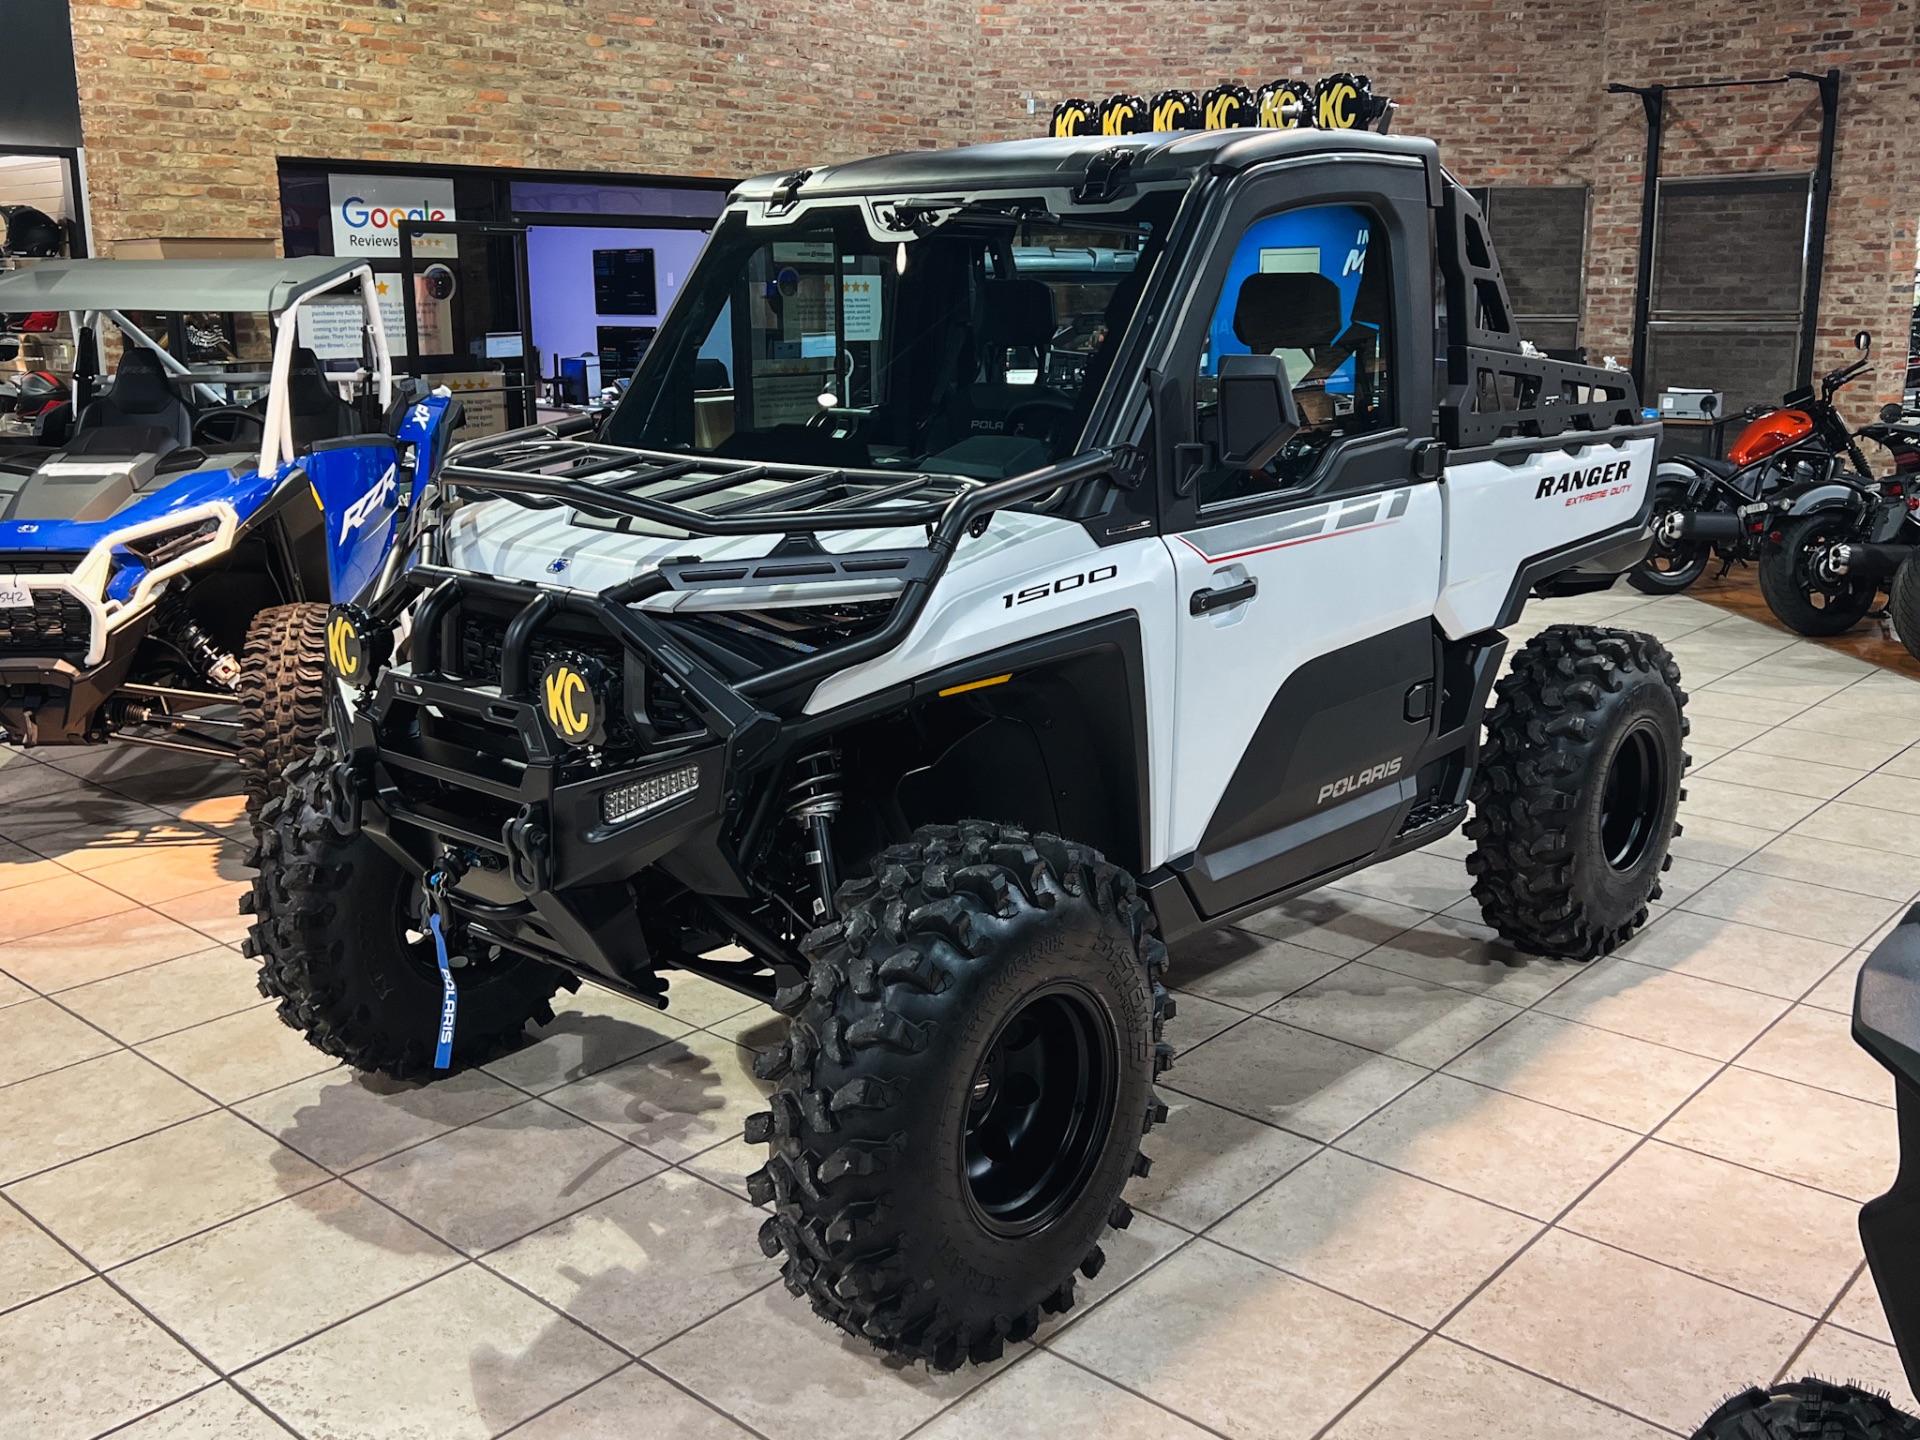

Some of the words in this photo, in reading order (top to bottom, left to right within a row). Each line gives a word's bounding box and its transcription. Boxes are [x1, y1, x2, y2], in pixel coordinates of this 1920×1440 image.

[1056, 107, 1085, 138] KC
[1103, 103, 1134, 136] KC
[1153, 99, 1186, 132] KC
[1205, 94, 1240, 131] KC
[1319, 82, 1356, 129] KC
[342, 196, 445, 238] Google
[349, 235, 399, 247] Reviews
[412, 403, 431, 431] XP
[971, 420, 1004, 431] POLA
[1534, 459, 1632, 500] RANGER
[1564, 489, 1609, 507] EXTREME
[1609, 483, 1633, 496] DUTY
[338, 461, 397, 548] RZR
[1002, 564, 1118, 610] 1500
[327, 616, 358, 676] KC
[546, 667, 589, 736] KC
[1316, 756, 1403, 805] POLARIS
[440, 967, 456, 1044] POLARIS
